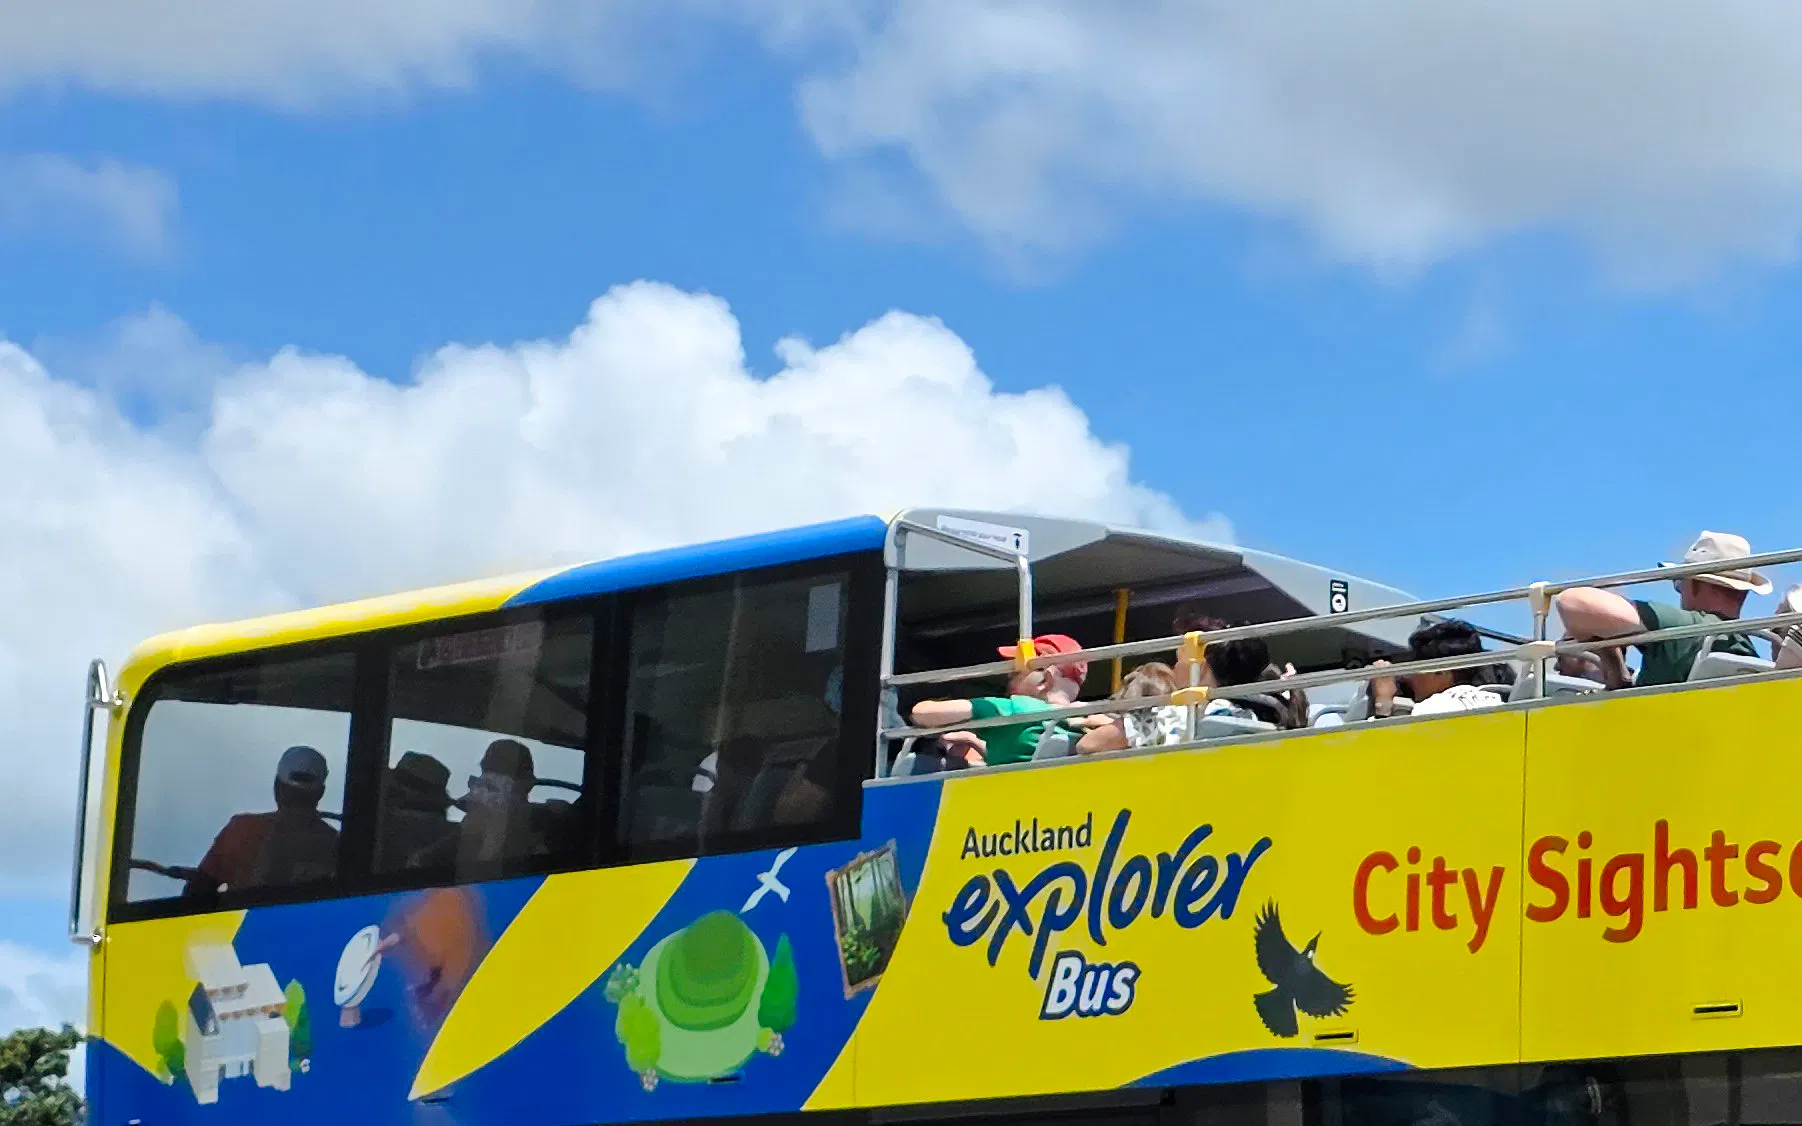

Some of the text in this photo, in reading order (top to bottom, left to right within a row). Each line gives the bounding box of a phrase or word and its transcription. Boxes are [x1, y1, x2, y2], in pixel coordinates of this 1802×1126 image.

[960, 812, 1093, 860] Auckland
[942, 809, 1272, 980] explorer
[1354, 846, 1506, 953] City
[1040, 951, 1141, 1020] Bus
